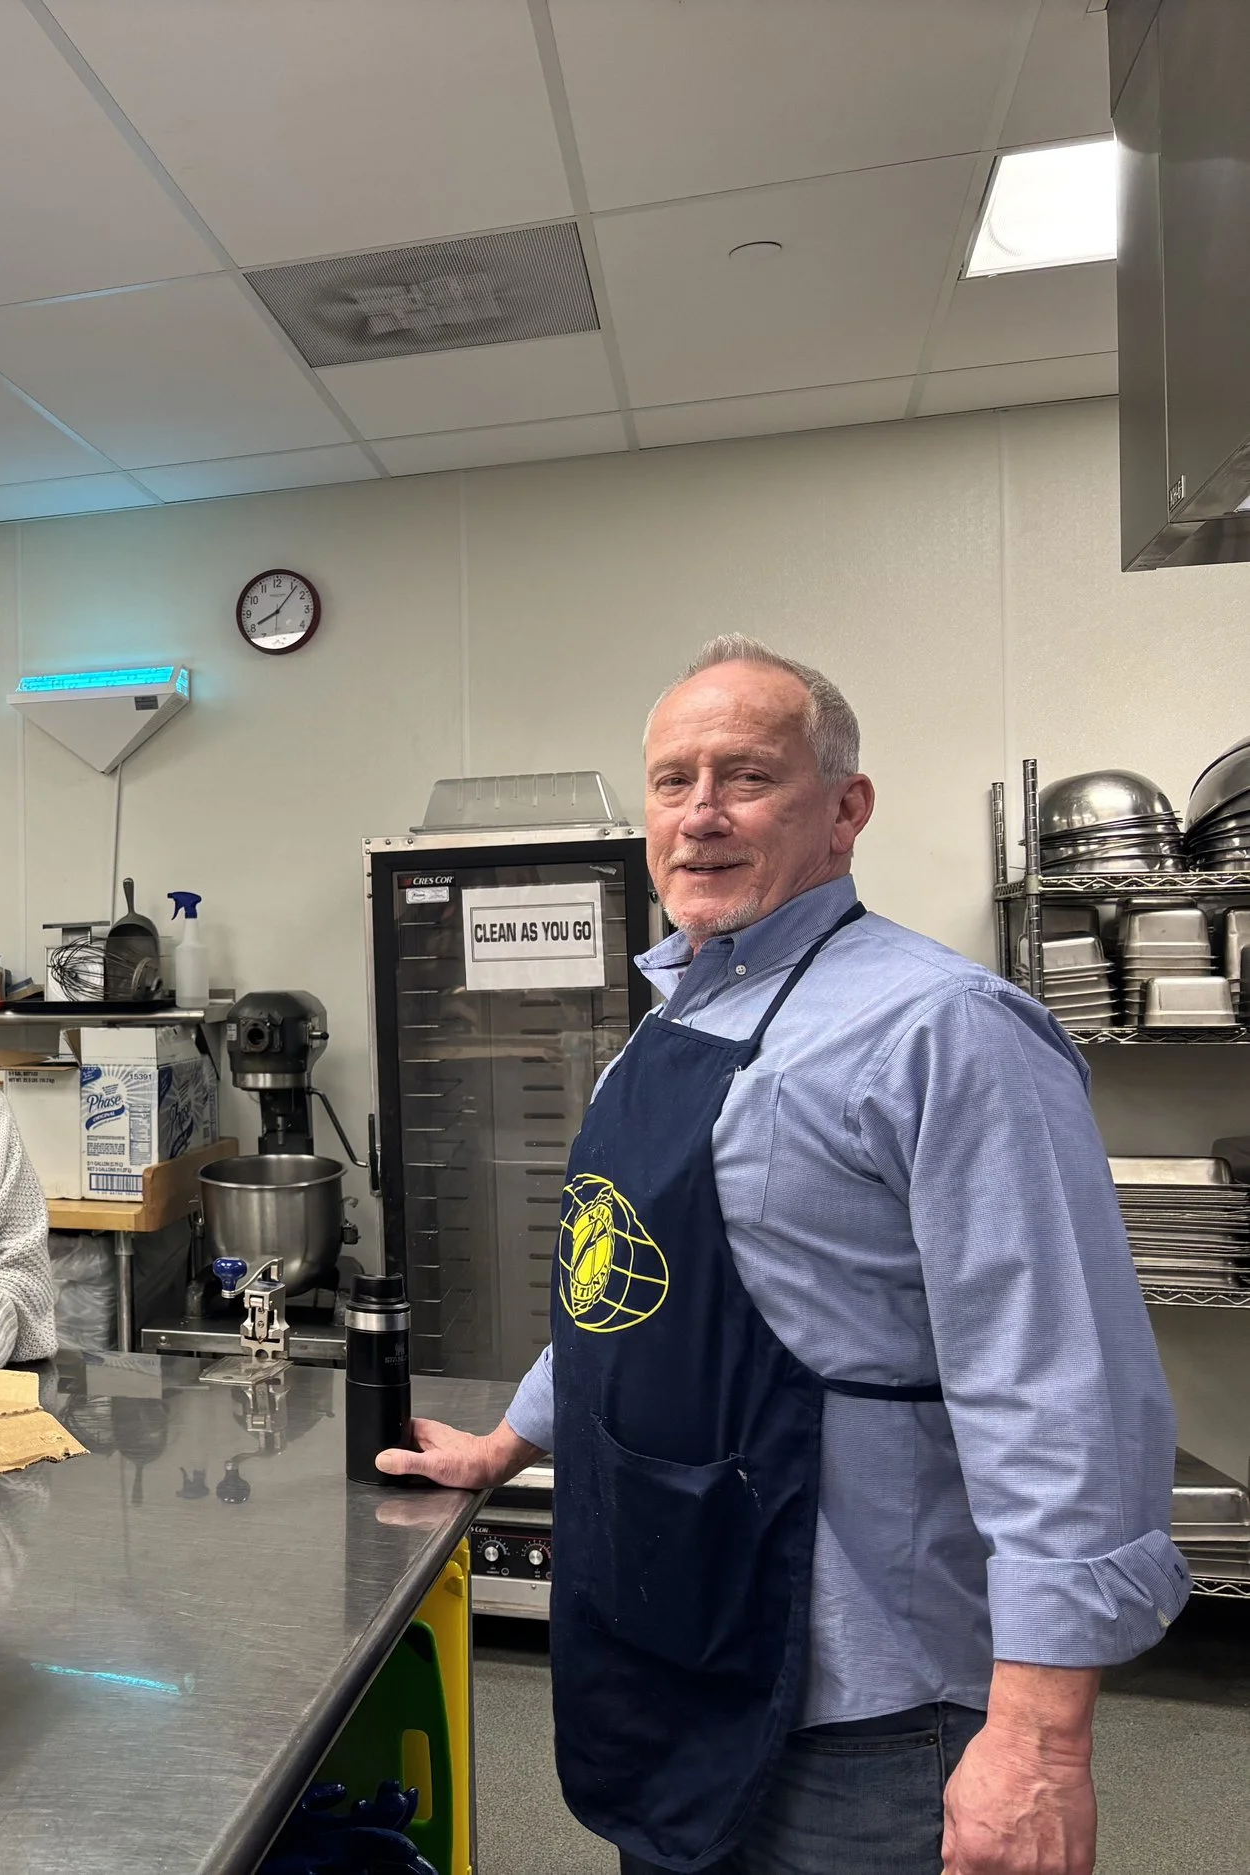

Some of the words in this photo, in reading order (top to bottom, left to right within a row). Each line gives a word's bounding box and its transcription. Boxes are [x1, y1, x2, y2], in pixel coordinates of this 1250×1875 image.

[273, 578, 282, 588] 12
[261, 584, 266, 593] 11
[300, 590, 306, 600] 2
[250, 596, 258, 605] 10
[304, 604, 310, 614] 3
[246, 610, 252, 618] 9
[250, 624, 256, 632] 8
[300, 620, 306, 629] 4
[413, 876, 434, 885] CRES
[435, 876, 454, 884] COR
[474, 922, 516, 943] CLEAN
[521, 922, 538, 942] AS
[542, 920, 568, 941] YOU
[574, 920, 592, 941] GO
[87, 1095, 121, 1112] Phase
